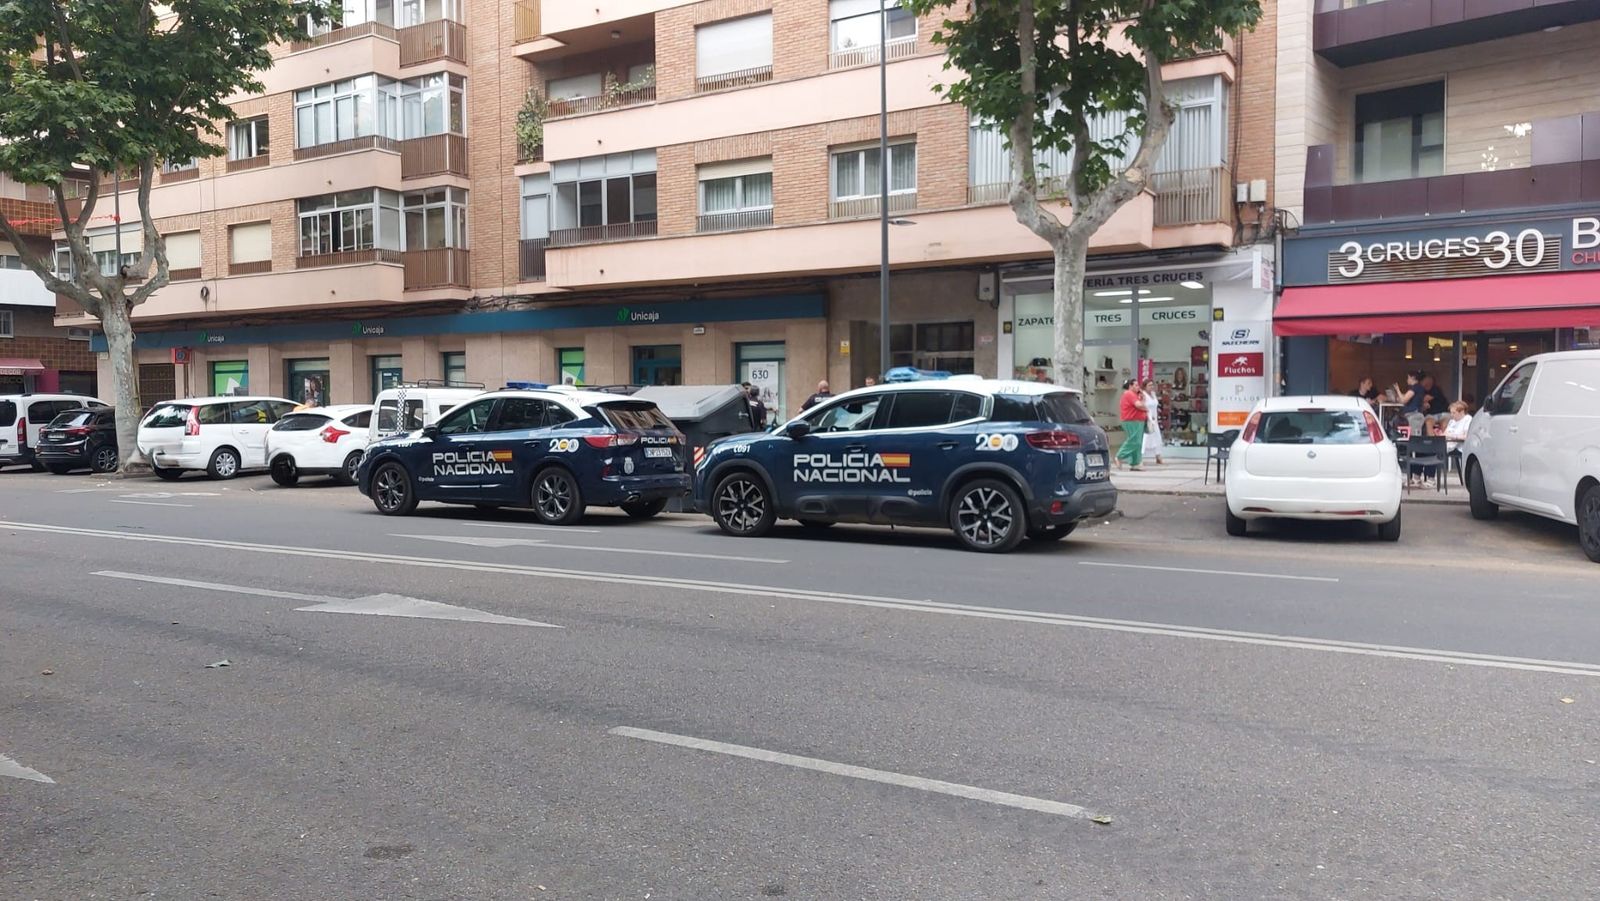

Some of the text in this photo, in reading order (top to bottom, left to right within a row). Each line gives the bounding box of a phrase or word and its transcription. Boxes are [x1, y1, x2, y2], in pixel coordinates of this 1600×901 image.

[1338, 228, 1546, 278] 3 CRUCES 30
[1571, 251, 1600, 265] CH
[1119, 275, 1150, 286] TRES
[1153, 271, 1204, 283] CRUCES
[630, 311, 660, 322] Unicaja
[1018, 310, 1196, 327] ZAPATE TRES CRUCES
[362, 325, 384, 335] Unicaja
[752, 369, 769, 380] 630
[1224, 366, 1256, 374] Fluchos
[432, 451, 496, 464] POLICIA
[793, 453, 884, 468] POLICIA
[433, 462, 514, 476] NACIONAL
[793, 468, 911, 483] NACIONAL
[907, 488, 933, 497] @policia
